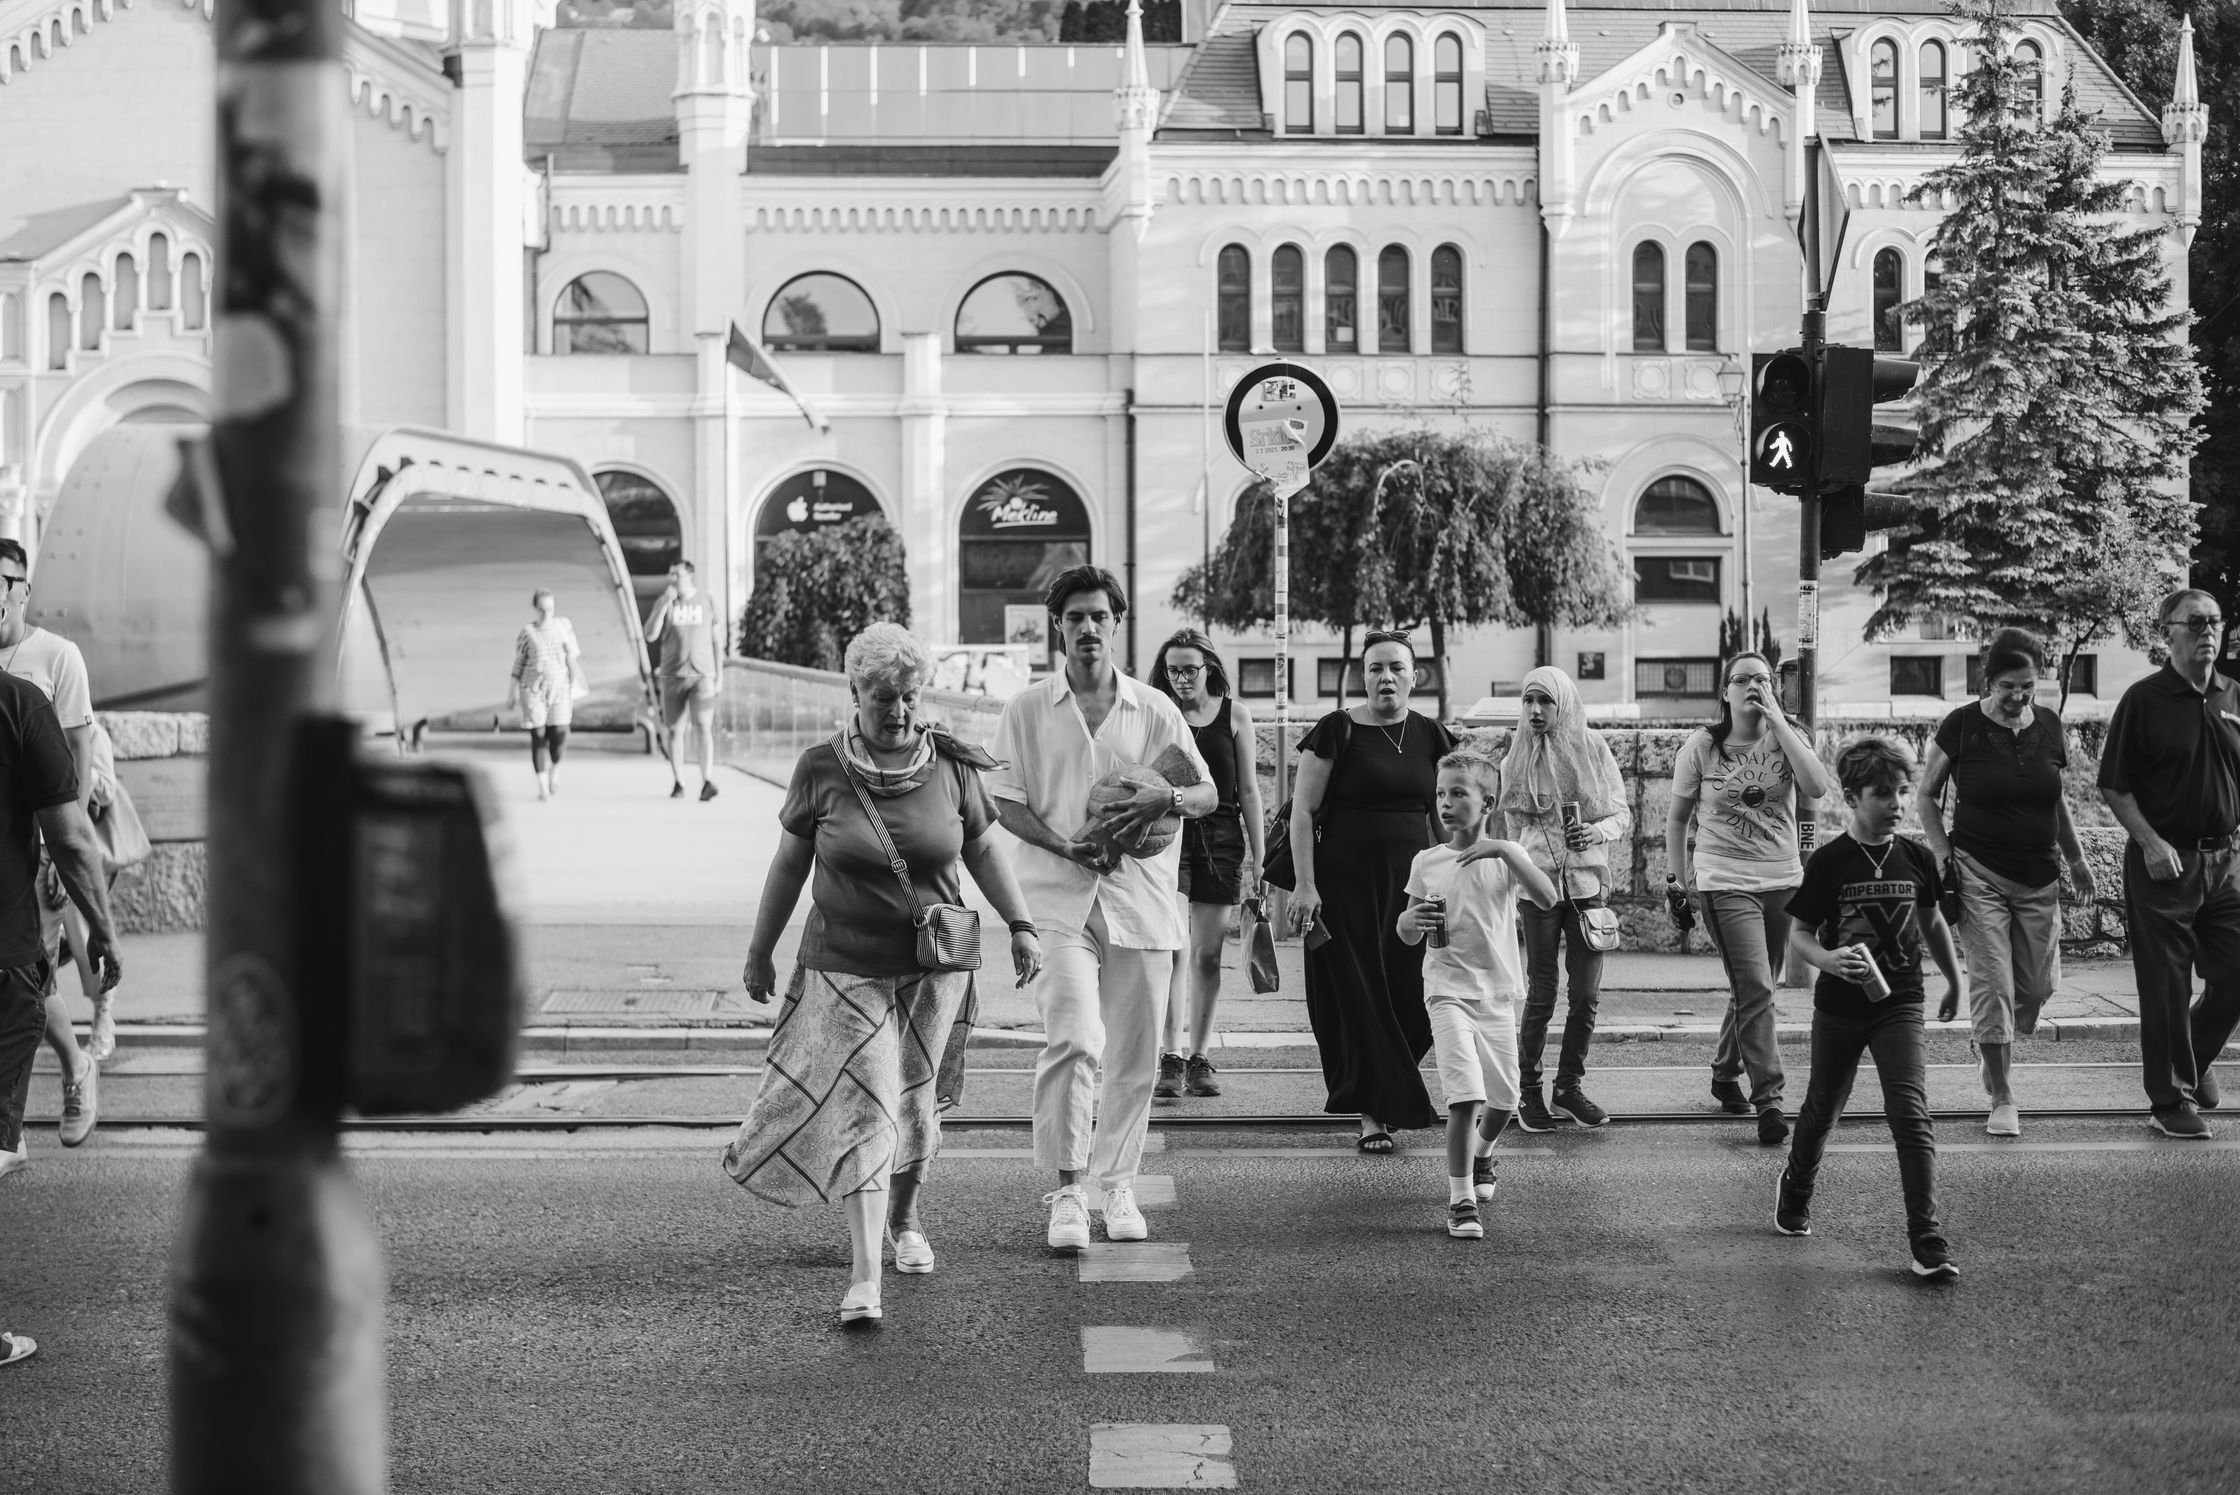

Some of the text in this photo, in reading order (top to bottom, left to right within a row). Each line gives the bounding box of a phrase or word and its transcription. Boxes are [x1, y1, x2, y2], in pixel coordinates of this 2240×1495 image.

[1712, 752, 1790, 790] ONE DAY OR
[1734, 770, 1767, 784] YOU
[1726, 812, 1787, 841] DAY ONE
[1801, 823, 1815, 849] BNE
